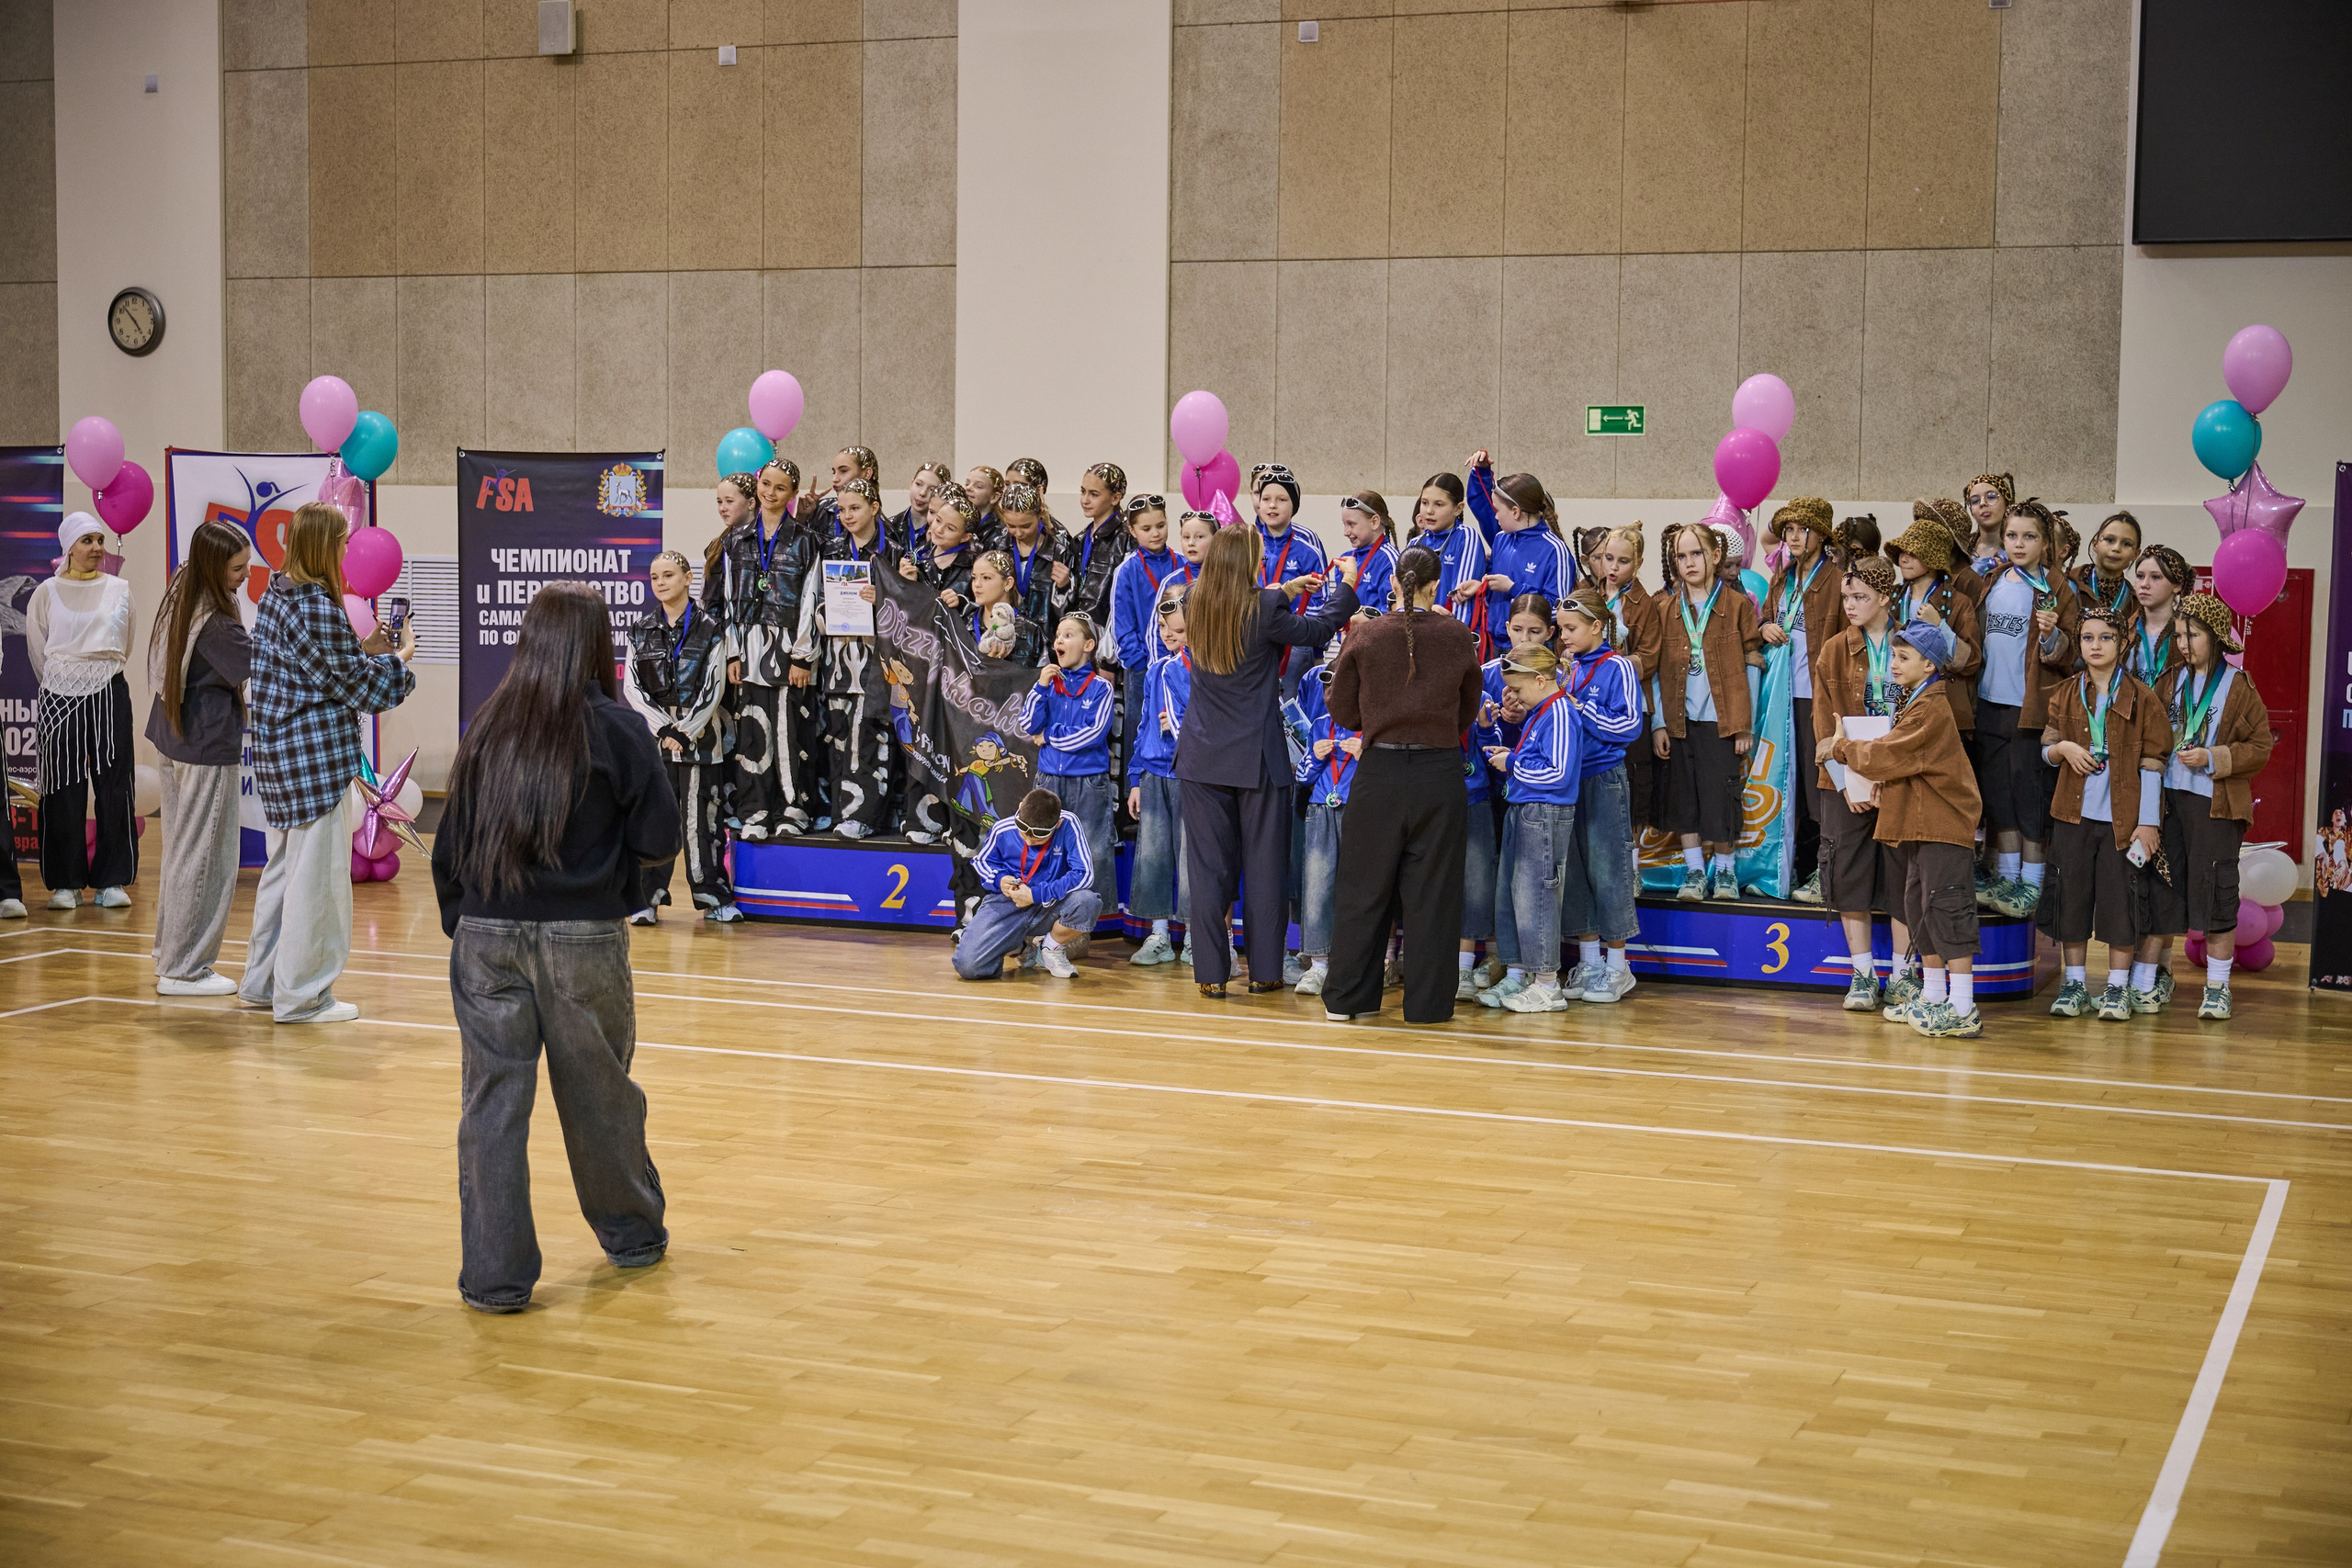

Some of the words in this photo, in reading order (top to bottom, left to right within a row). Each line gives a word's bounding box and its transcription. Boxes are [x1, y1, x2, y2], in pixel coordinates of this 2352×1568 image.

[475, 475, 535, 513] FSA
[491, 548, 631, 574] ЧЕМПИОНАТ
[477, 584, 491, 604] и
[497, 580, 645, 605] ПЕРТВО
[480, 629, 499, 645] ПО
[879, 863, 910, 909] 2
[1760, 922, 1791, 974] 3
